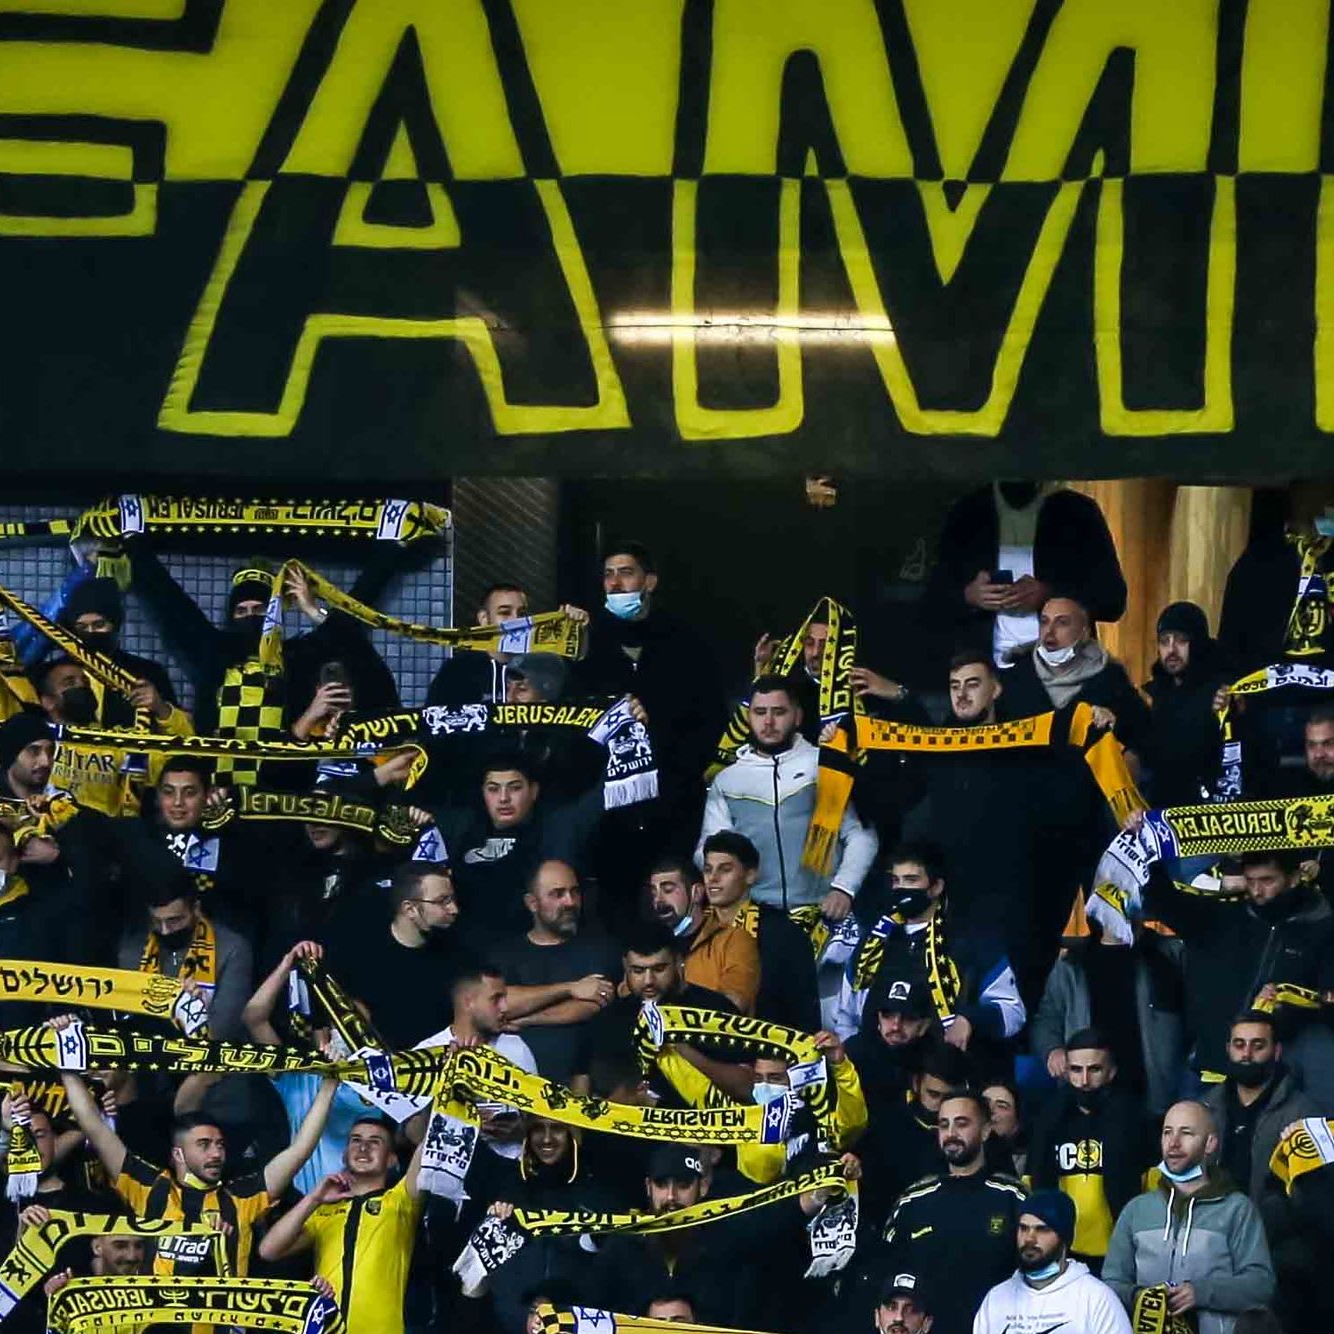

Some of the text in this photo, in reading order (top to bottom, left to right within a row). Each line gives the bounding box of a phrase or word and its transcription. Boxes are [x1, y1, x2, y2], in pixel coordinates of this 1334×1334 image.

[493, 702, 598, 731] JERUSALEM
[240, 787, 377, 828] Jerusalem
[0, 967, 113, 994] ירושלים
[680, 1008, 806, 1046] ירושלים
